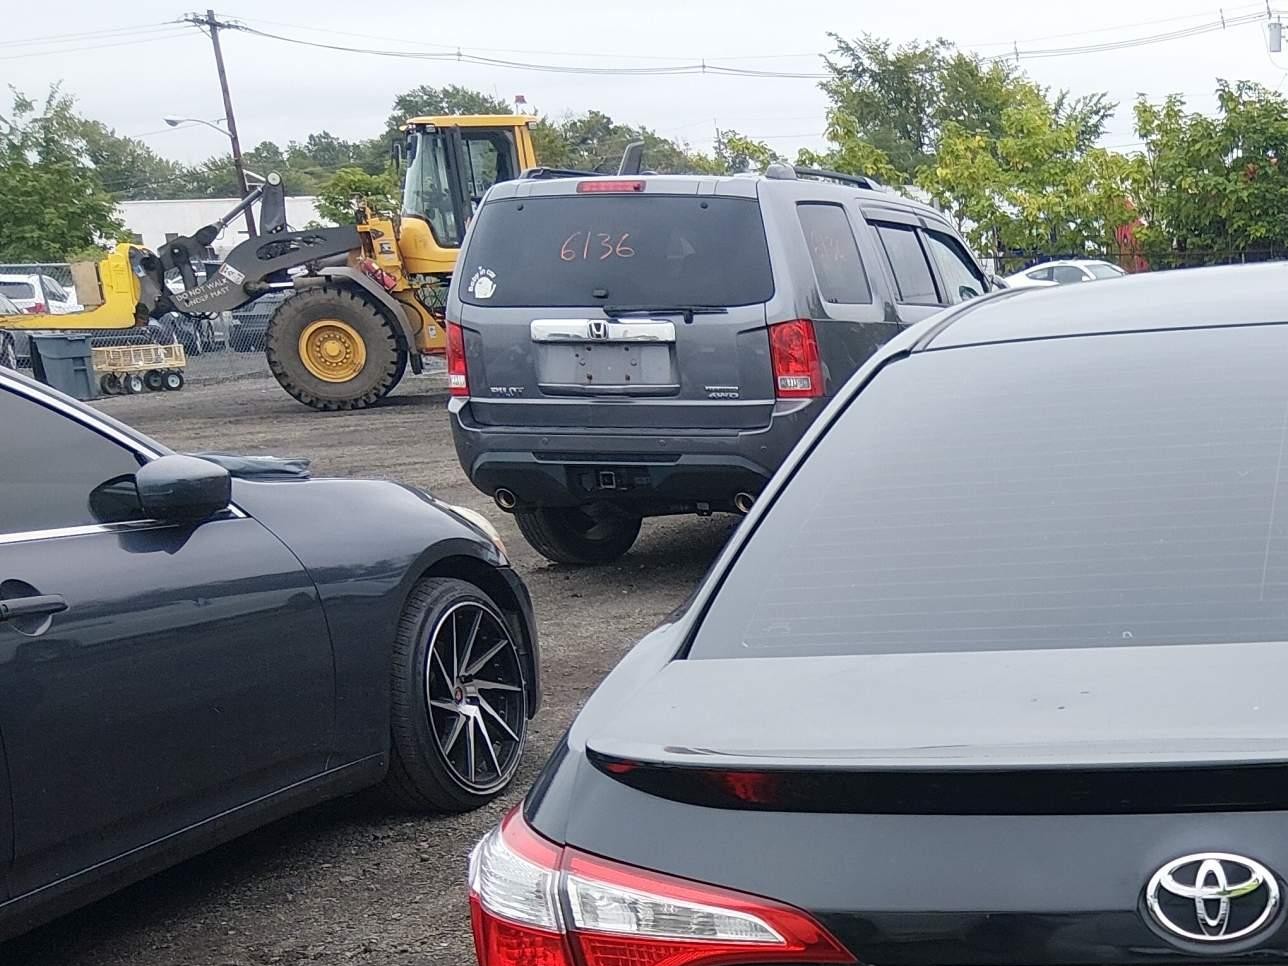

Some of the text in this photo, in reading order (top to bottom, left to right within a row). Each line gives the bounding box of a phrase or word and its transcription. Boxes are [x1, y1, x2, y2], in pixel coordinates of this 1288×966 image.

[560, 231, 635, 260] 6136
[175, 278, 228, 302] DO NOT WALK
[184, 285, 230, 307] UNDER MAST
